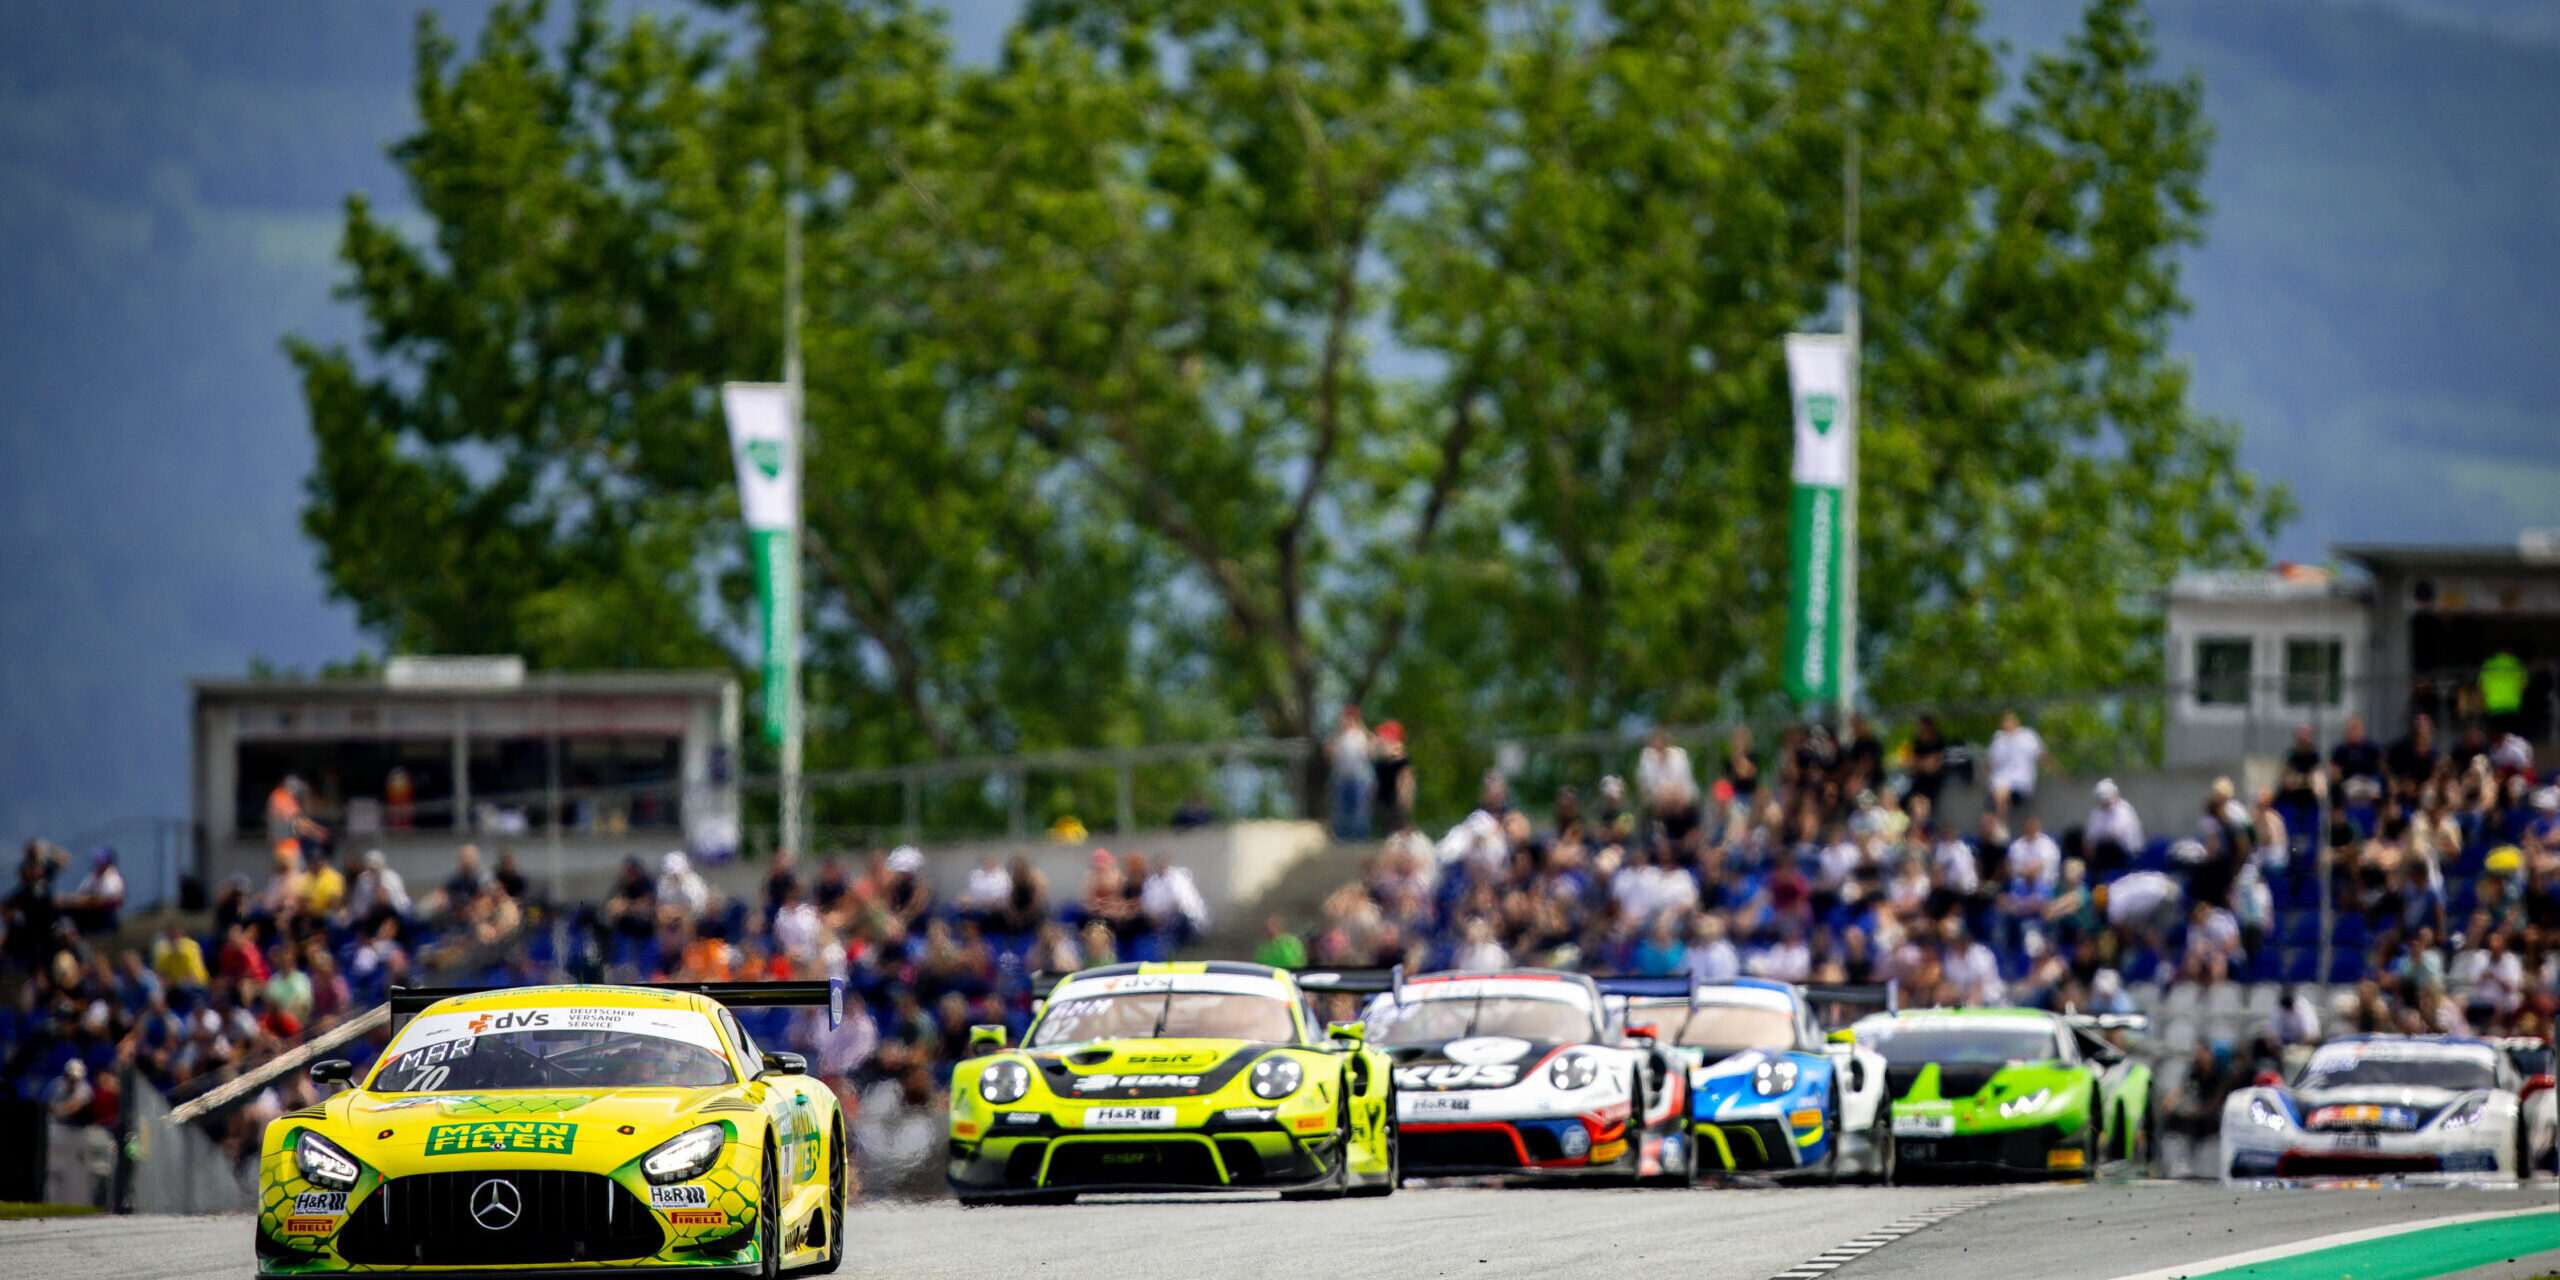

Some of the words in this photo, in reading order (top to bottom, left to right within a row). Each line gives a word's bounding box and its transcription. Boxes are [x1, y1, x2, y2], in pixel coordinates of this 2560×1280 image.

[495, 1010, 549, 1029] dvs
[568, 1014, 621, 1022] VERSAND
[569, 1008, 635, 1017] DEUTSCHER
[398, 1035, 476, 1073] MAR
[402, 1065, 450, 1092] 70
[1099, 1108, 1136, 1120] H&R
[437, 1123, 569, 1138] MANN
[434, 1133, 566, 1151] FILTER
[297, 1193, 328, 1210] H&R
[651, 1187, 684, 1203] H&R
[288, 1219, 333, 1231] PIRELLI
[671, 1212, 722, 1223] PIRELLI
